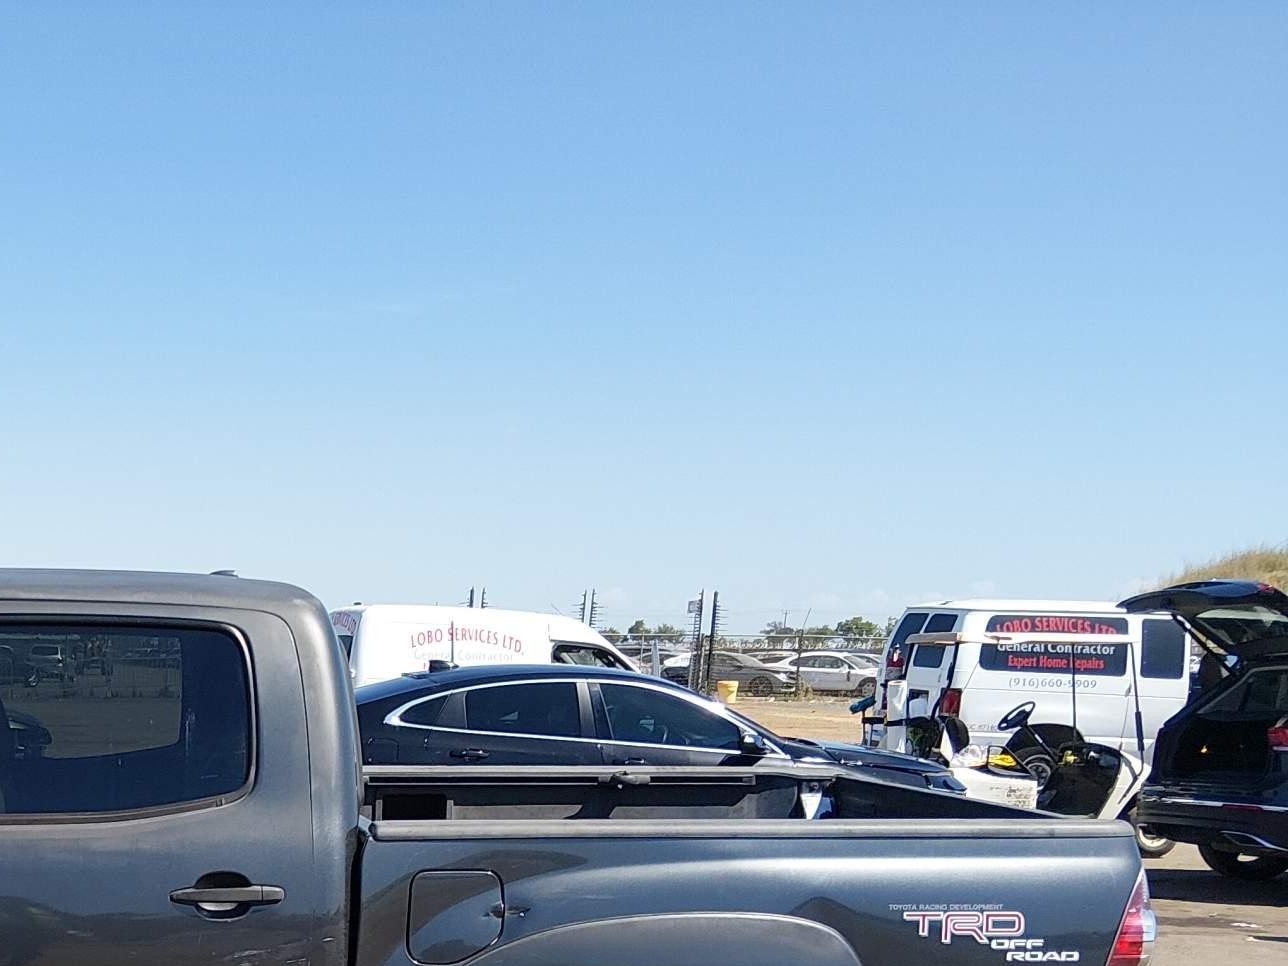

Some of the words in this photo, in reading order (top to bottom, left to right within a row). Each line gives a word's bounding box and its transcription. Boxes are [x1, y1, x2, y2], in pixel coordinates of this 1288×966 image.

[996, 618, 1031, 634] LOBO
[1034, 617, 1091, 634] SERVICES
[410, 628, 443, 648] LOBO
[447, 627, 498, 646] SERVICES
[997, 642, 1044, 654] General
[1048, 643, 1115, 655] Contractor
[414, 650, 453, 662] Genera
[1008, 655, 1037, 669] Expert
[1039, 656, 1068, 668] Home
[902, 911, 1026, 944] TRD
[990, 939, 1045, 950] OFF
[1006, 951, 1080, 962] ROAD
